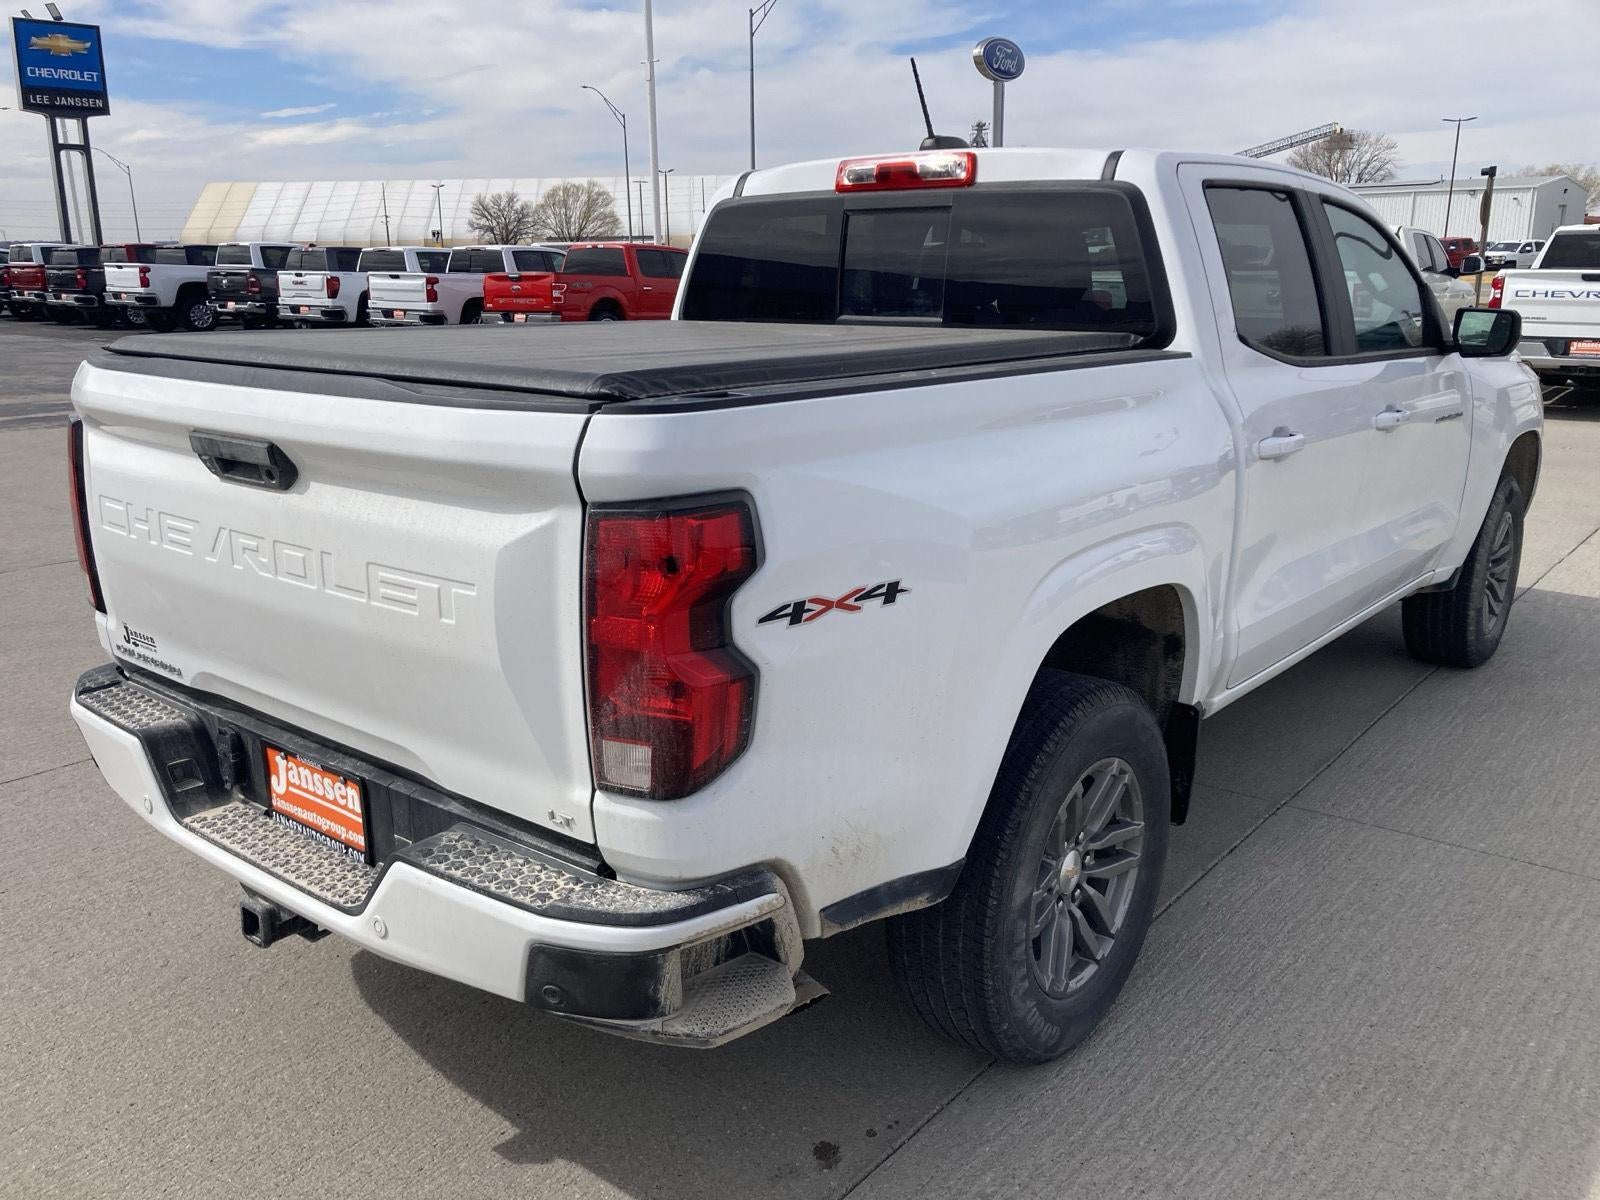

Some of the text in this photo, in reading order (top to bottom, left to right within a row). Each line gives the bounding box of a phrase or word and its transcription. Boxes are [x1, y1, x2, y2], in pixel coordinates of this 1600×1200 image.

[993, 45, 1018, 72] Ford
[26, 66, 98, 82] CHEVROLET
[30, 94, 103, 108] LEE JANSSEN
[123, 625, 156, 645] Janssen
[270, 755, 362, 814] Janssen
[547, 807, 577, 832] LT
